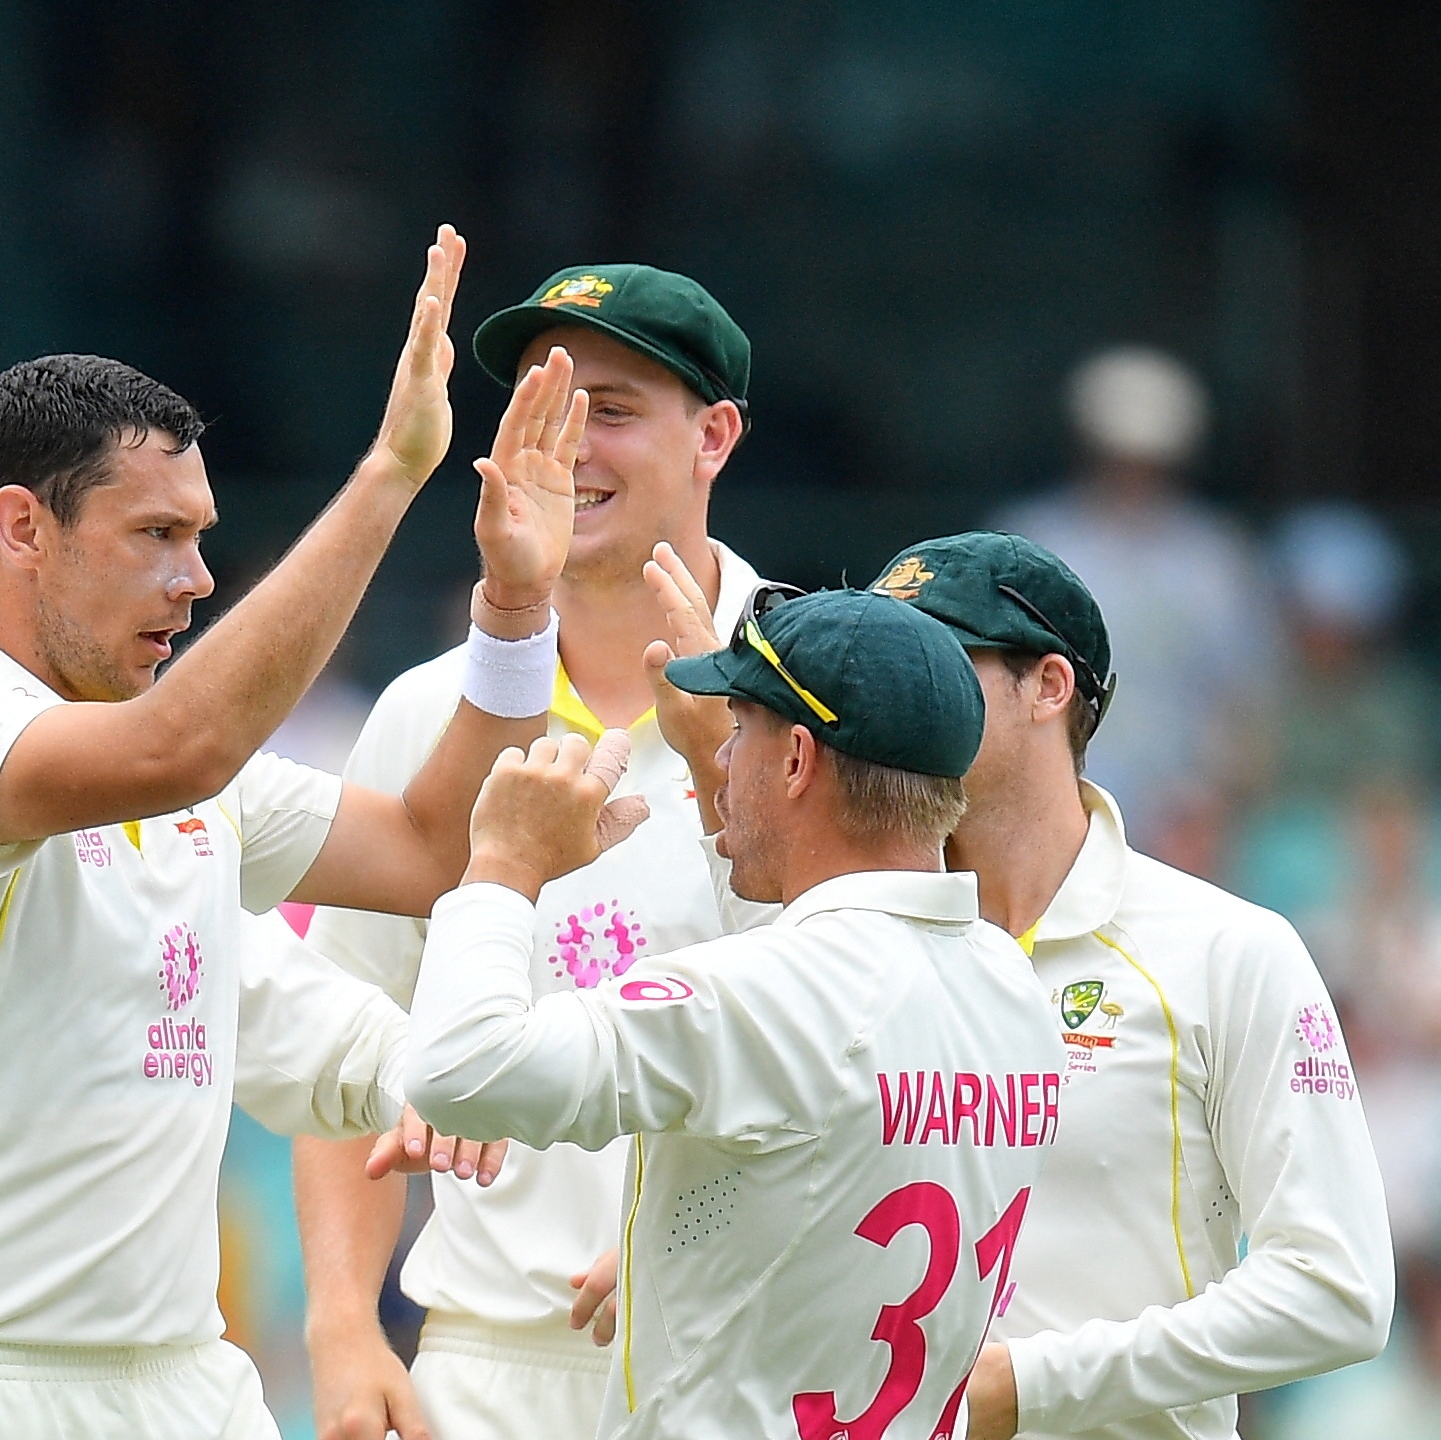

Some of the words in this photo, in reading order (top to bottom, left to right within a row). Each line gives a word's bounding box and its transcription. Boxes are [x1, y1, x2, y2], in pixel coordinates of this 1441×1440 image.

[147, 1016, 206, 1050] alinta
[144, 1053, 212, 1087] energy
[1294, 1056, 1349, 1079] alinta
[1290, 1078, 1355, 1101] energy
[878, 1070, 1059, 1146] WARNER
